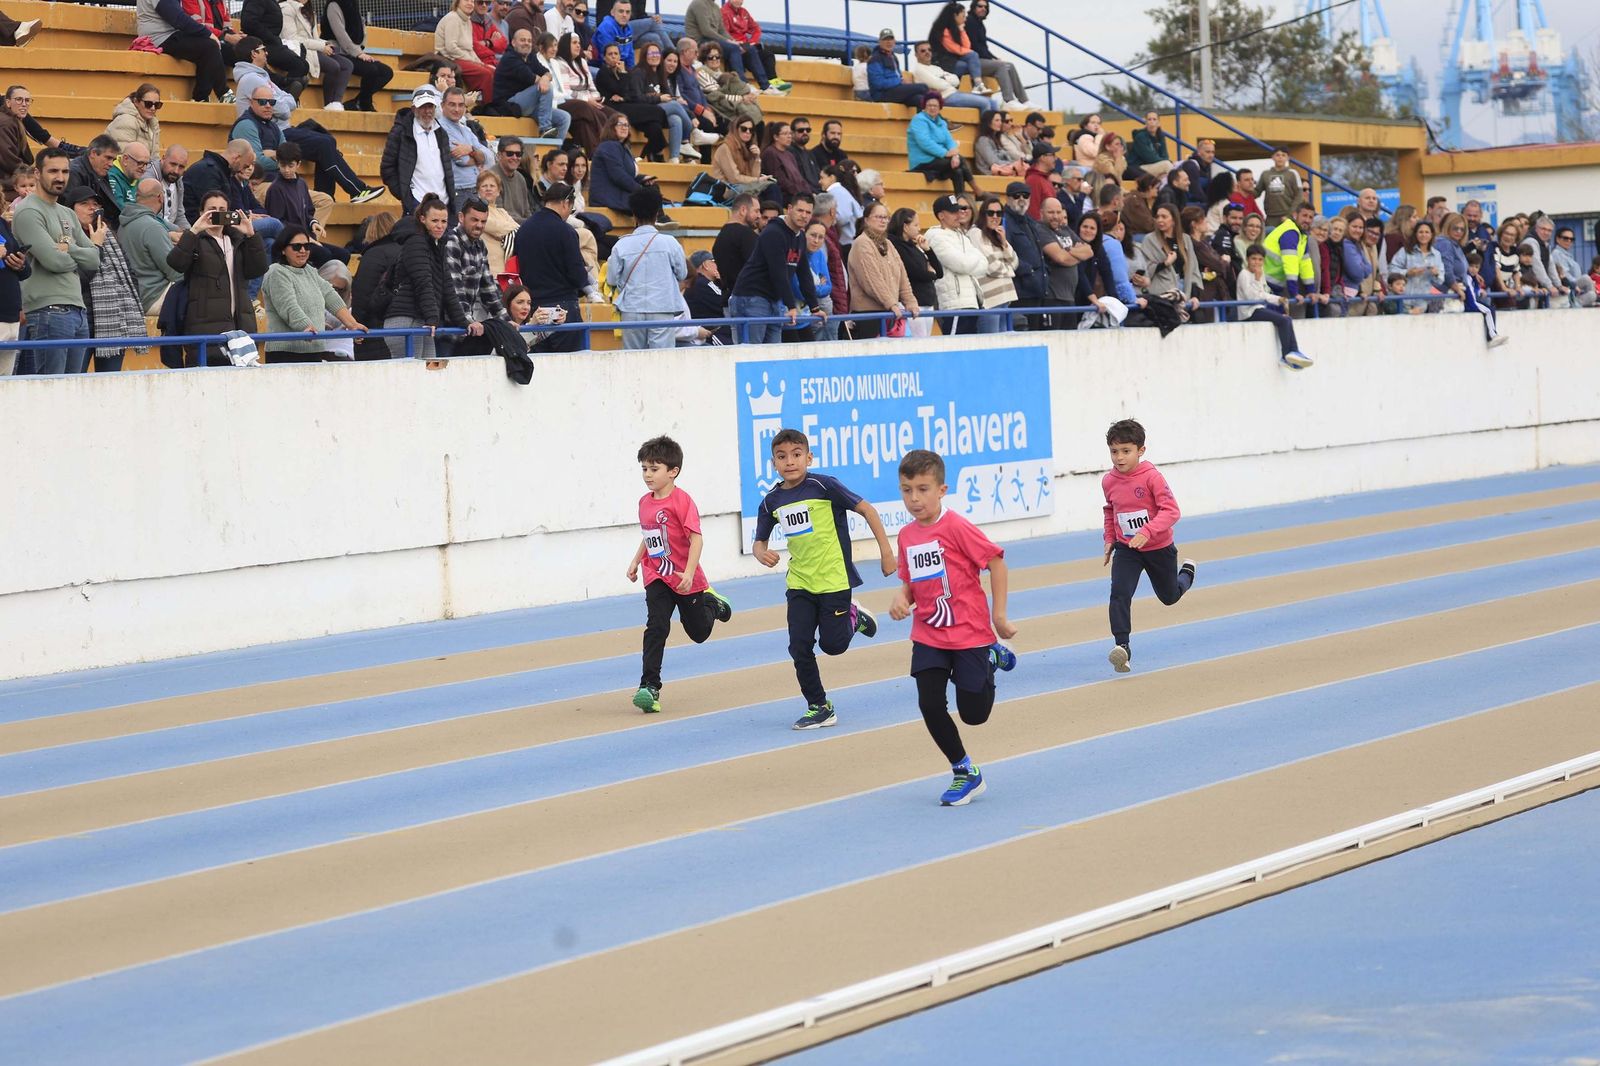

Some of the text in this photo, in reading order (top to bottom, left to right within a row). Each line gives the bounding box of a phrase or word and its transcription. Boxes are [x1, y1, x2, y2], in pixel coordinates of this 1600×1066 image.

[800, 371, 924, 405] ESTADIO MUNICIPAL
[802, 401, 1028, 479] Enrique Talavera
[785, 511, 809, 527] 1007
[645, 536, 662, 549] 081
[913, 551, 941, 569] 1095
